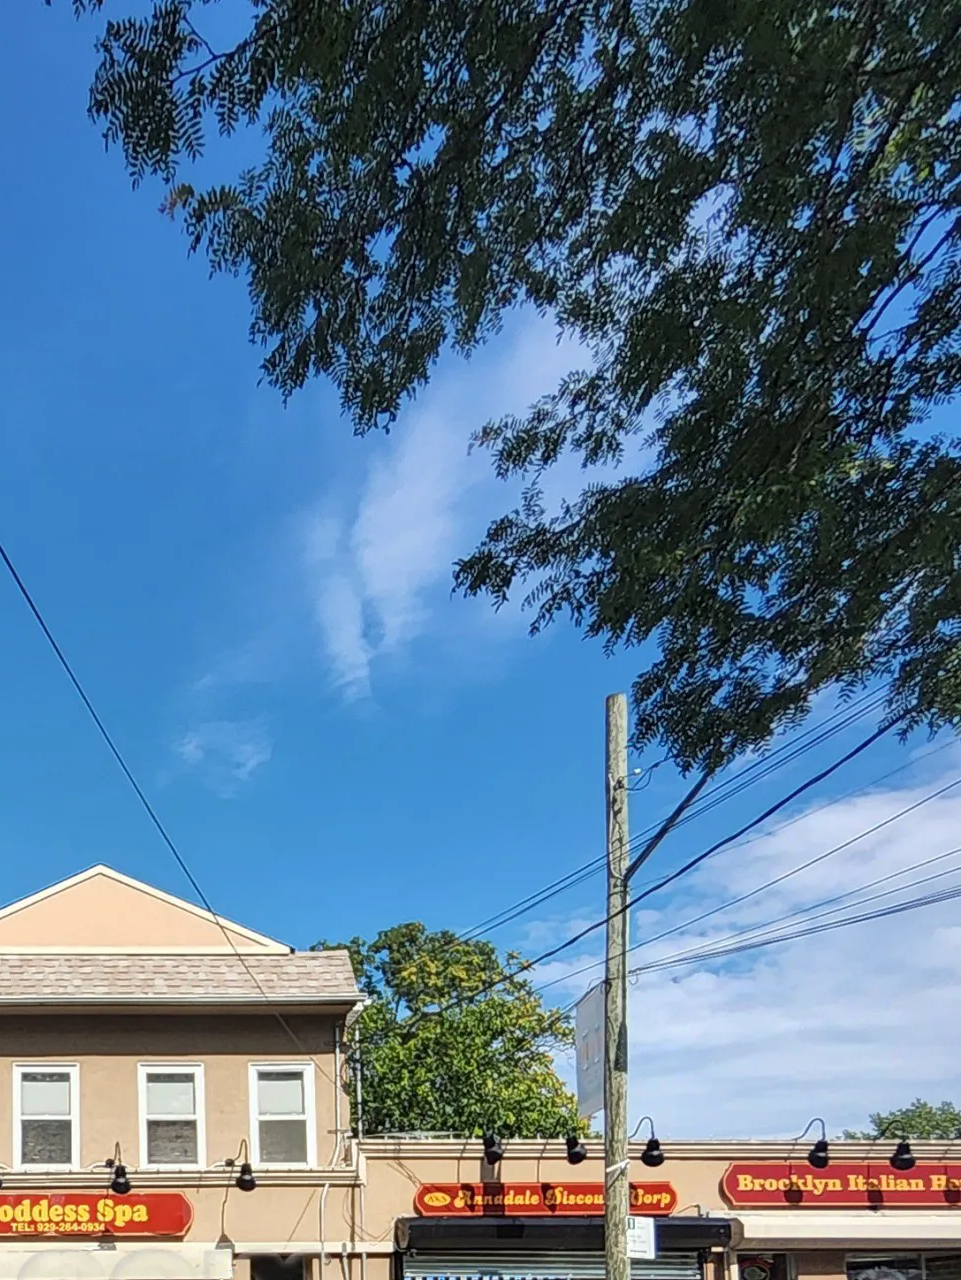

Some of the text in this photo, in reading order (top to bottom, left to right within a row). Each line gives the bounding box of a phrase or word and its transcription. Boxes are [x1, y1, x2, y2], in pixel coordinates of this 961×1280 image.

[737, 1174, 843, 1195] Brooklyn
[847, 1174, 926, 1191] Italian
[454, 1188, 539, 1208] Annadale
[545, 1186, 606, 1209] Discou
[96, 1198, 148, 1228] Spa
[11, 1222, 105, 1232] TEL: 929-264-0934
